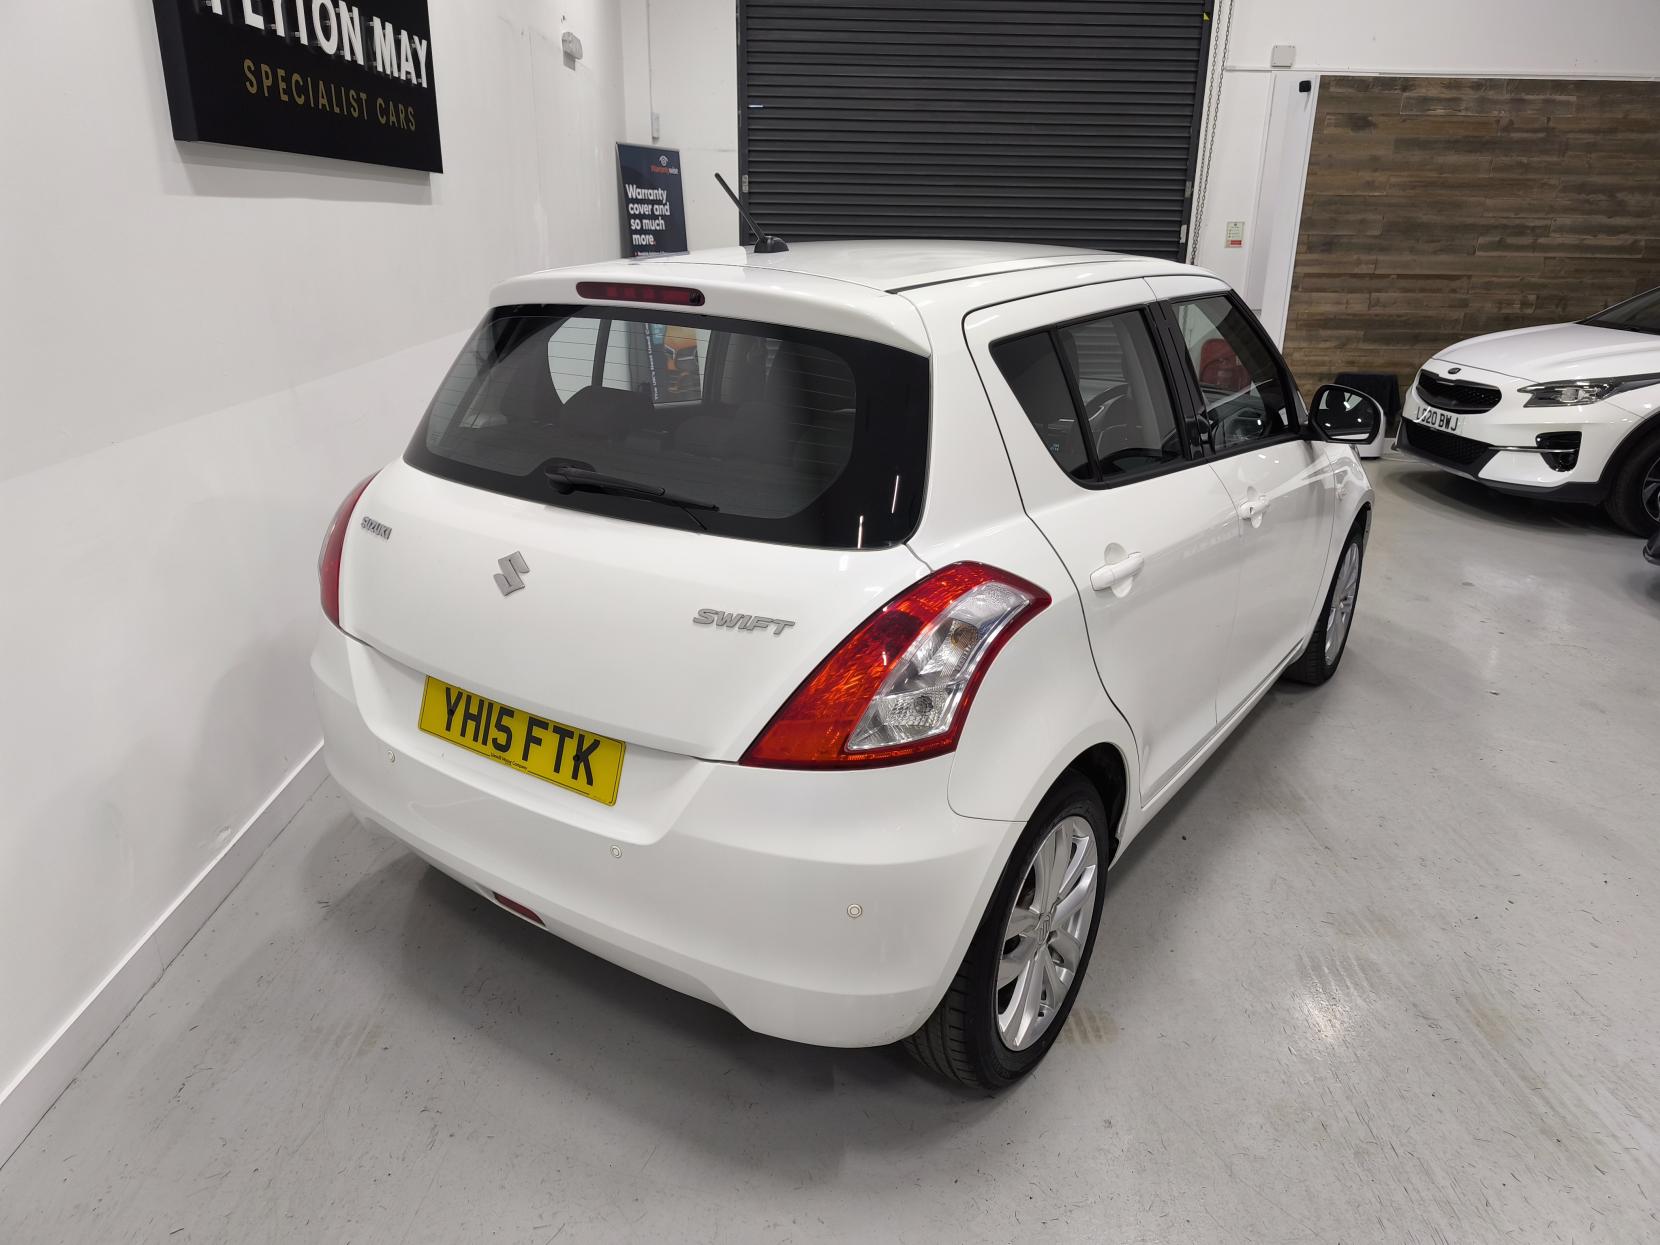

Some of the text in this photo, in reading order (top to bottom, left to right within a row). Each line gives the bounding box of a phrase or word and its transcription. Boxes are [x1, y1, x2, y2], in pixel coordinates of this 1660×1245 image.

[372, 15, 428, 89] MAY
[243, 58, 416, 132] SPECIALIST CARS
[625, 183, 667, 204] Warranty
[628, 201, 671, 216] cover and
[630, 216, 666, 231] so much
[632, 234, 656, 246] more.
[1438, 413, 1459, 431] BWJ
[361, 516, 392, 541] SUZUKI
[692, 608, 796, 636] SWIFT
[445, 687, 601, 786] YH15 FTK
